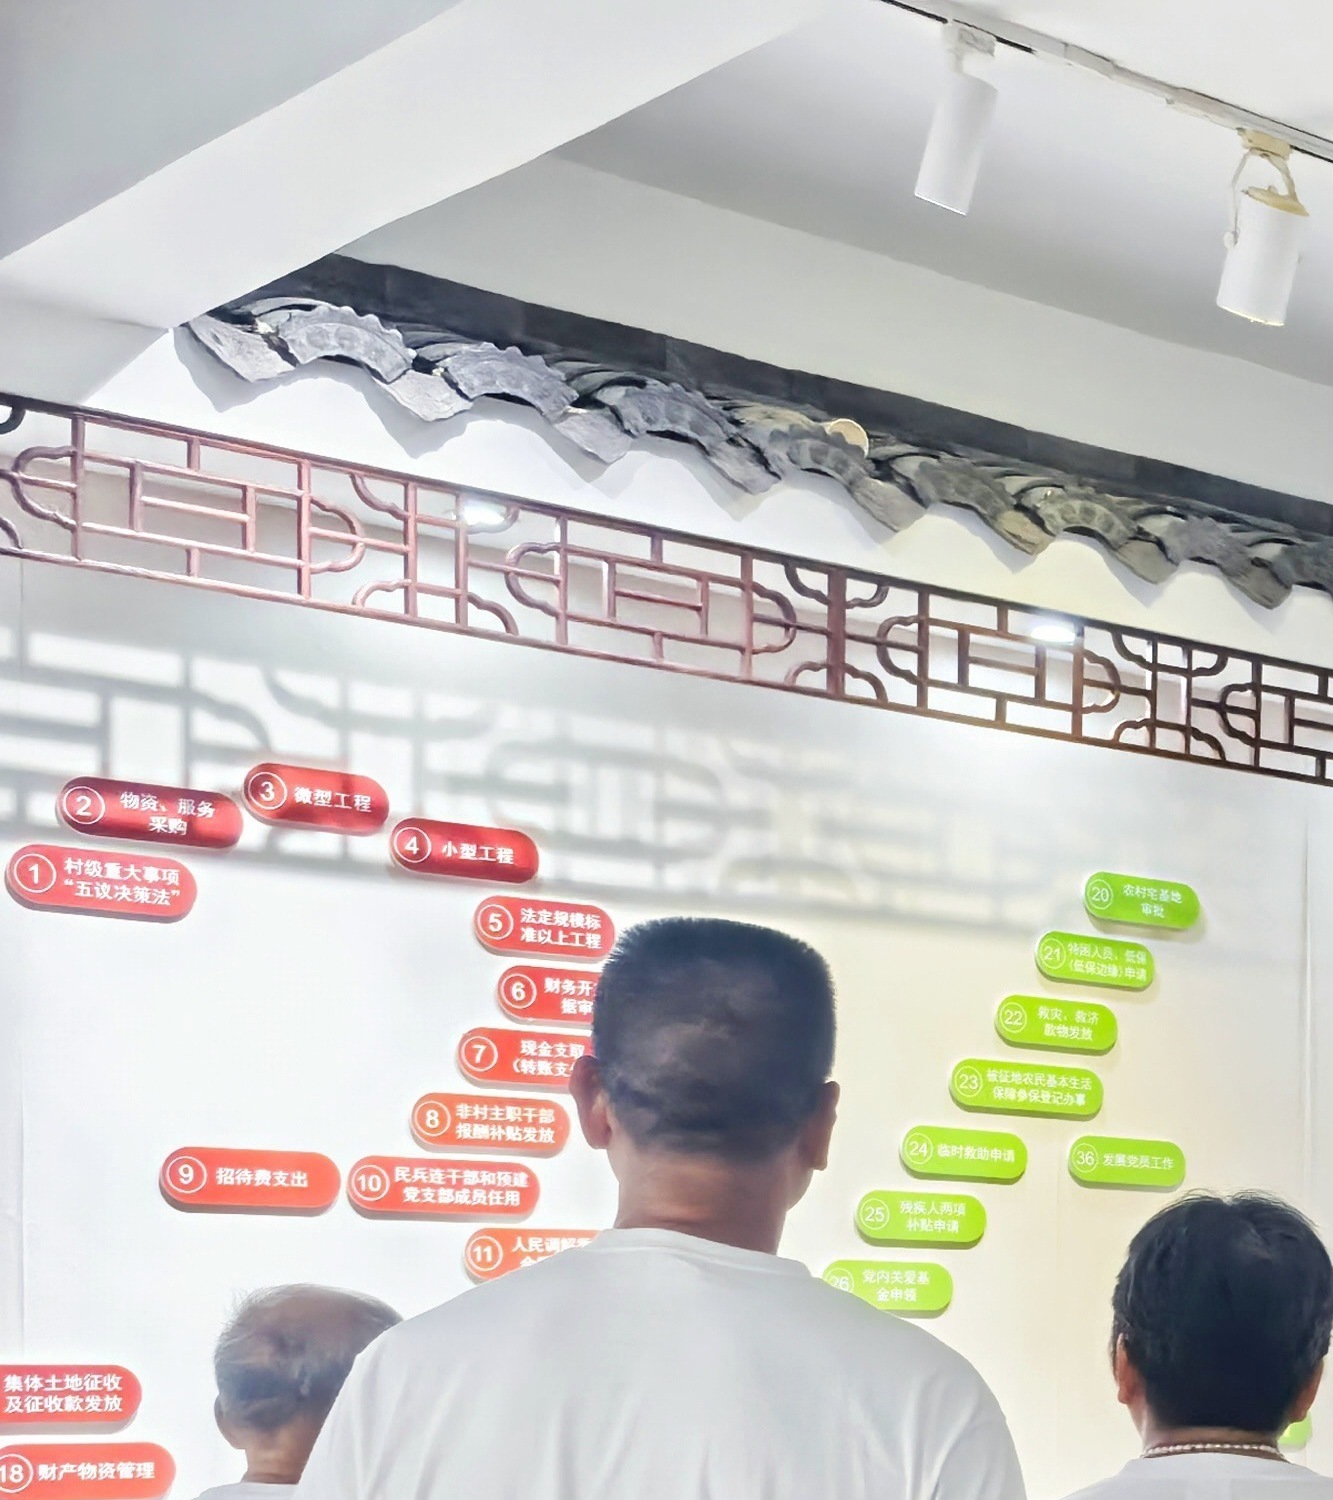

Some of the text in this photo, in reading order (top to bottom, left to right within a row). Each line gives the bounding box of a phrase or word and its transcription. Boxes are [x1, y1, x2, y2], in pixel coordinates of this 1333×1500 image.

[120, 791, 216, 818] 物资、服务
[294, 787, 372, 813] 微型工程
[149, 816, 188, 836] 采购
[442, 841, 515, 865] 小型工程
[64, 858, 180, 886] 村级重大事项
[64, 879, 181, 906] “五议决策法”
[1123, 884, 1182, 904] 农村宅基地
[520, 907, 602, 930] 法定规模标
[1141, 903, 1165, 918] 审批
[520, 927, 602, 949] 准以上工程
[544, 977, 597, 997] 财务开
[1044, 1023, 1093, 1041] 款物发放
[520, 1039, 585, 1059] 现金支取
[513, 1059, 574, 1077] （转账支
[987, 1069, 1092, 1090] 被征地农民基本生活
[455, 1104, 555, 1124] 非村主职干部
[455, 1122, 555, 1144] 报酬补贴发放
[937, 1142, 1016, 1163] 临时救助申请
[1102, 1153, 1174, 1170] 发展党员工作
[215, 1166, 309, 1189] 招待费支出
[357, 1174, 380, 1193] 10
[402, 1186, 521, 1207] 党支部成员任用
[900, 1200, 966, 1217] 残疾人两项
[906, 1218, 959, 1233] 补贴申请
[863, 1269, 930, 1285] 党内关爱基
[877, 1288, 917, 1302] 金申领
[3, 1373, 123, 1392] 集体土地征收
[3, 1395, 123, 1413] 及征收款发放
[0, 1464, 24, 1483] 18
[38, 1461, 155, 1482] 财产物资管理
